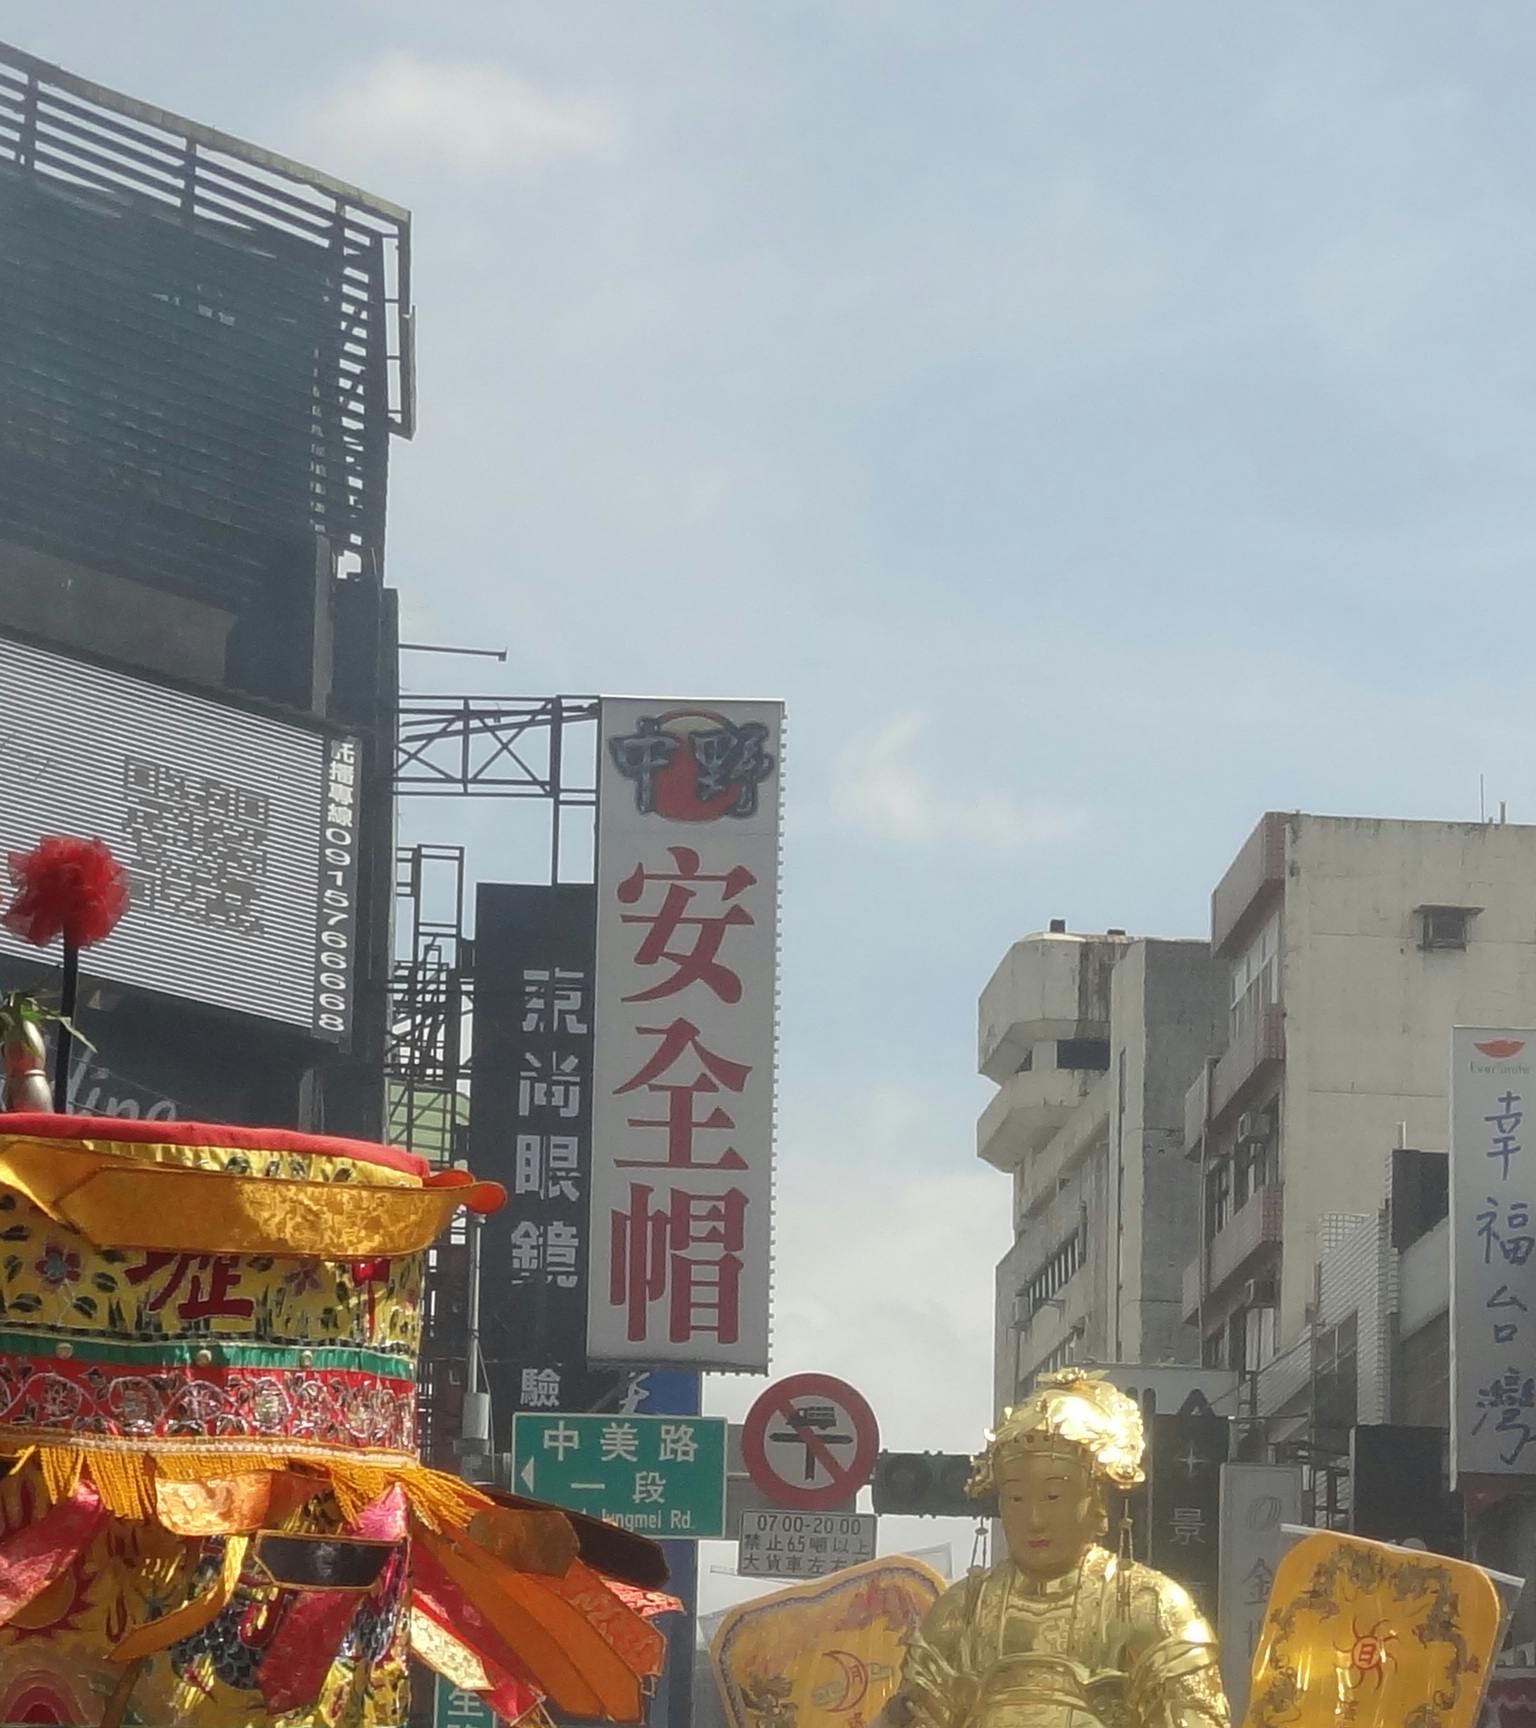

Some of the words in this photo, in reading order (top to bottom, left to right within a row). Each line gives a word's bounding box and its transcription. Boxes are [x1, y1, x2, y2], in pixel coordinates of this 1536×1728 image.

[609, 846, 757, 1344] 安全帽
[1472, 1090, 1536, 1466] 幸福台灣
[542, 1423, 700, 1462] 中美路
[570, 1472, 667, 1504] 一段
[742, 1553, 867, 1575] 大貨車左右
